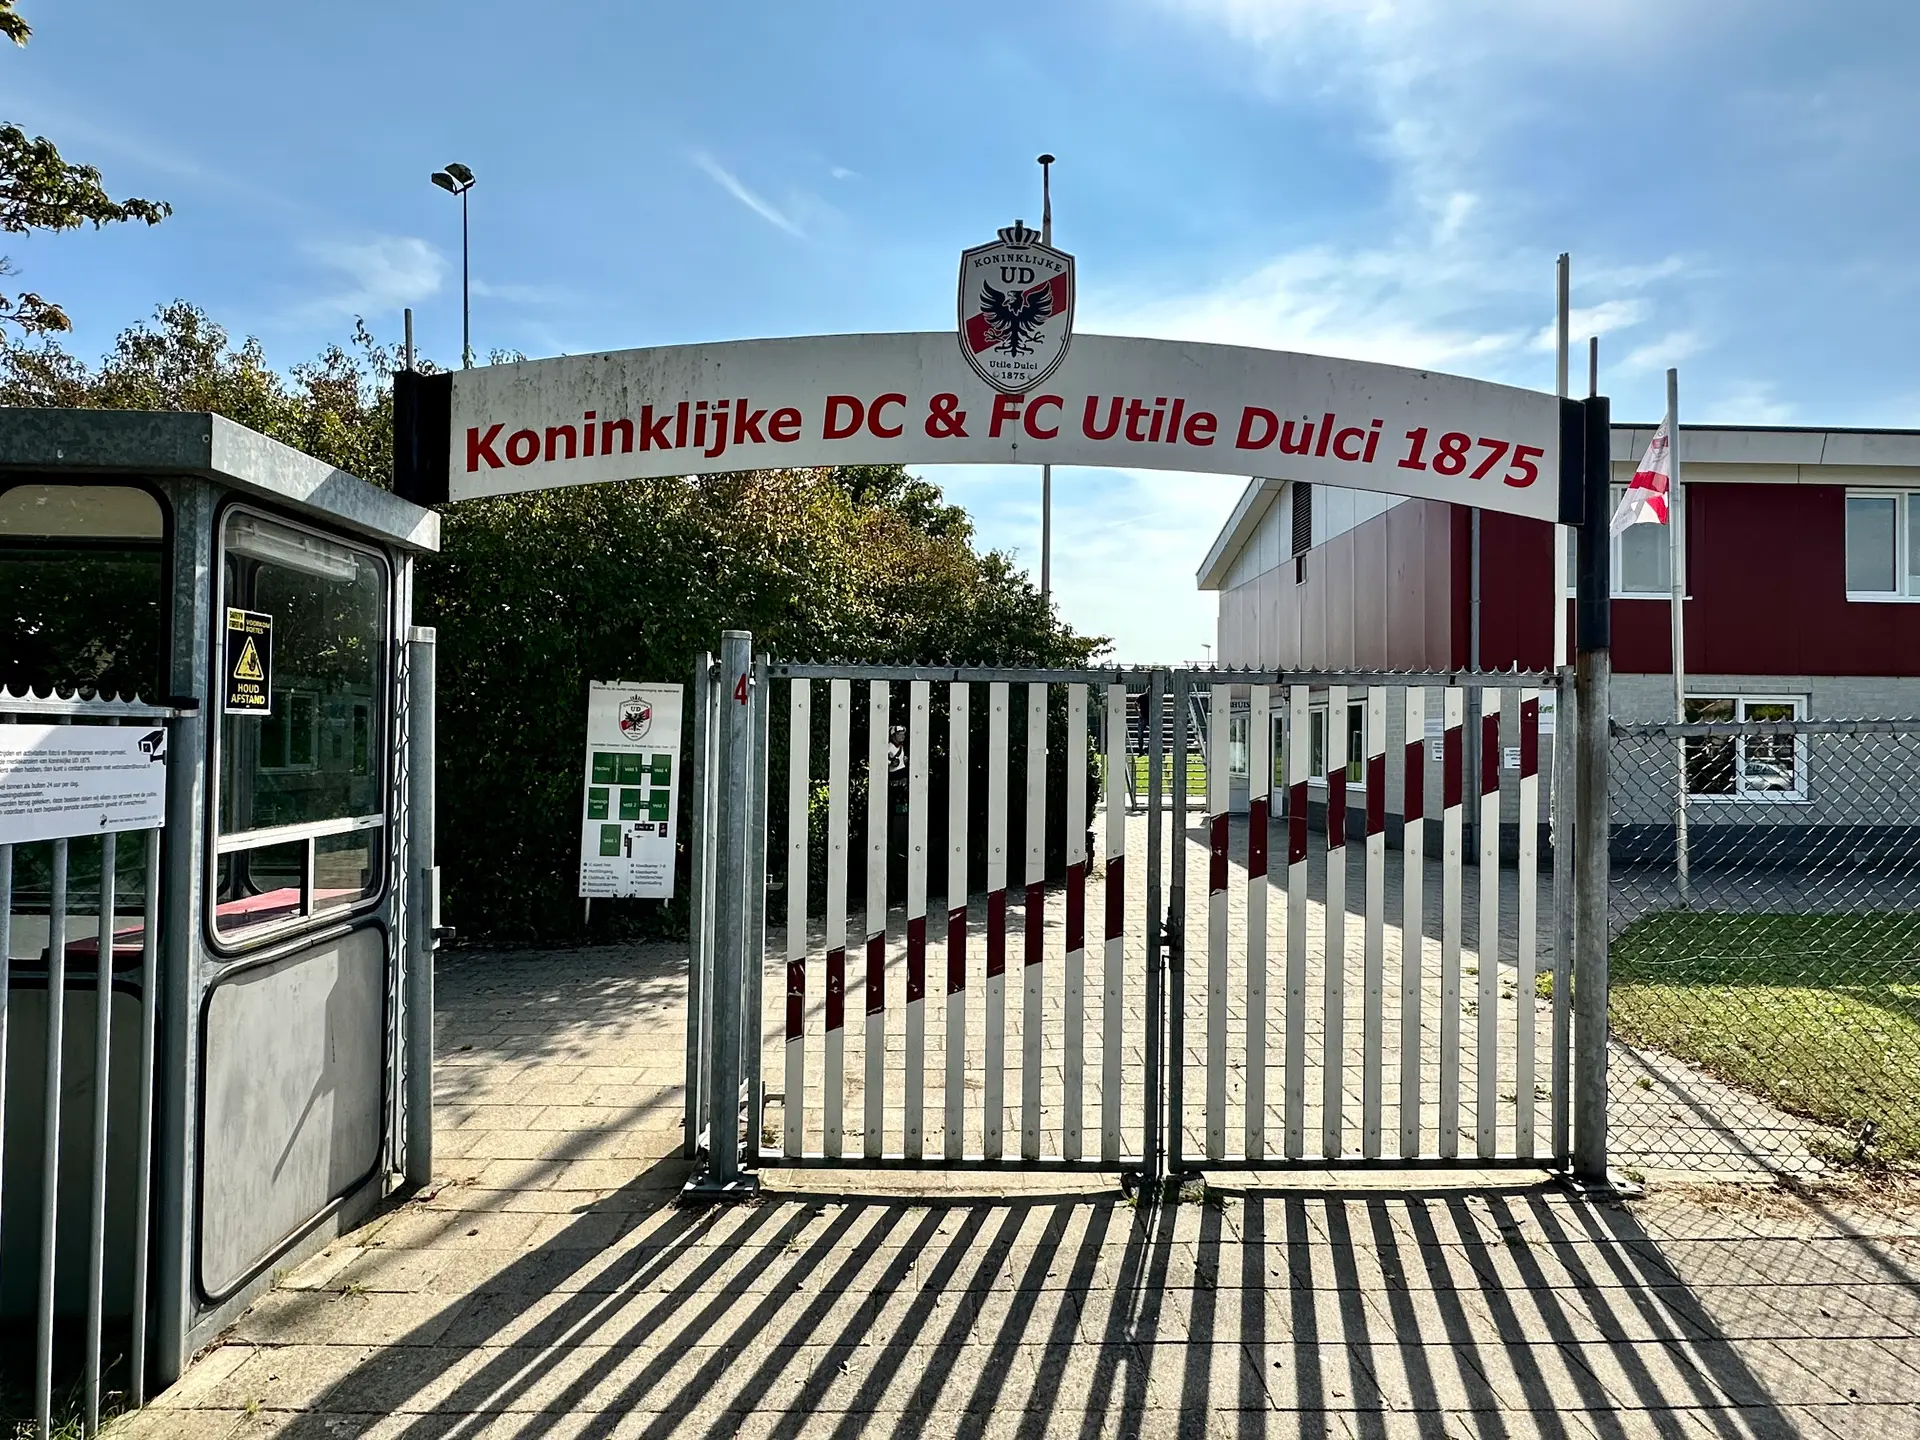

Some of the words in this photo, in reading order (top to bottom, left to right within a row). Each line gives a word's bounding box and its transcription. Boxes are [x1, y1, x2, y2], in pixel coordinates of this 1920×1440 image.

[973, 254, 1062, 273] KONINKLIJKE
[1001, 266, 1035, 284] UD
[989, 360, 1011, 369] Utile
[1014, 361, 1038, 370] Dulci
[1001, 371, 1026, 380] 1875
[466, 398, 802, 473] Koninklijke
[822, 393, 907, 440] DC
[924, 392, 970, 439] &
[988, 394, 1064, 441] FC
[1081, 395, 1218, 447] Utile
[1235, 406, 1384, 464] Dulci
[1397, 426, 1545, 489] 1875
[237, 683, 260, 694] HOUD
[734, 673, 748, 705] 4
[230, 693, 266, 705] AFSTAND
